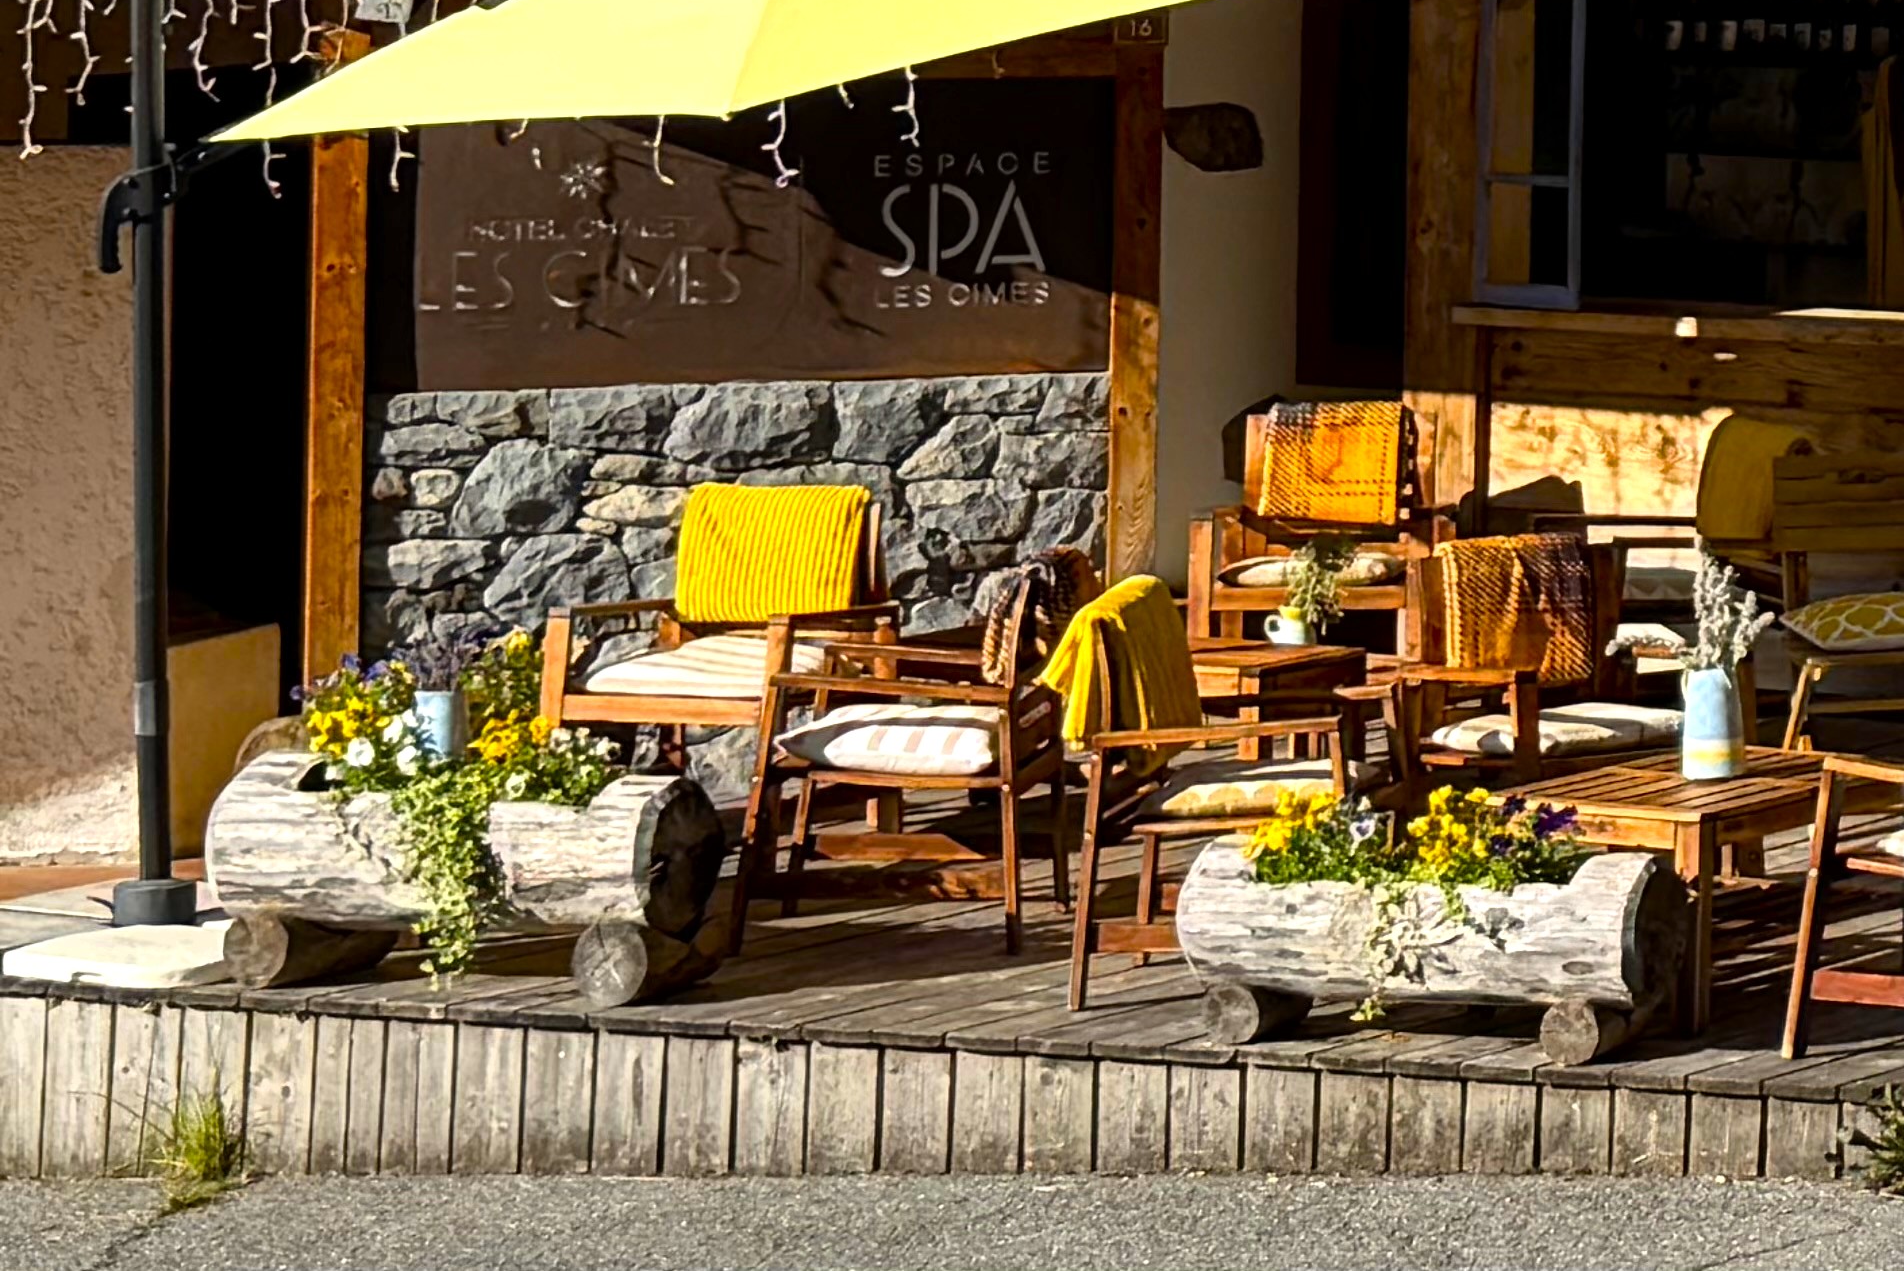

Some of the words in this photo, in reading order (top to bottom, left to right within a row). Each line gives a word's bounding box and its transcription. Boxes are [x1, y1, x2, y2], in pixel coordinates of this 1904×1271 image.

[873, 150, 1052, 178] ESPACE
[879, 178, 1047, 279] SPA
[875, 283, 933, 309] LES
[947, 281, 1051, 308] CIMES
